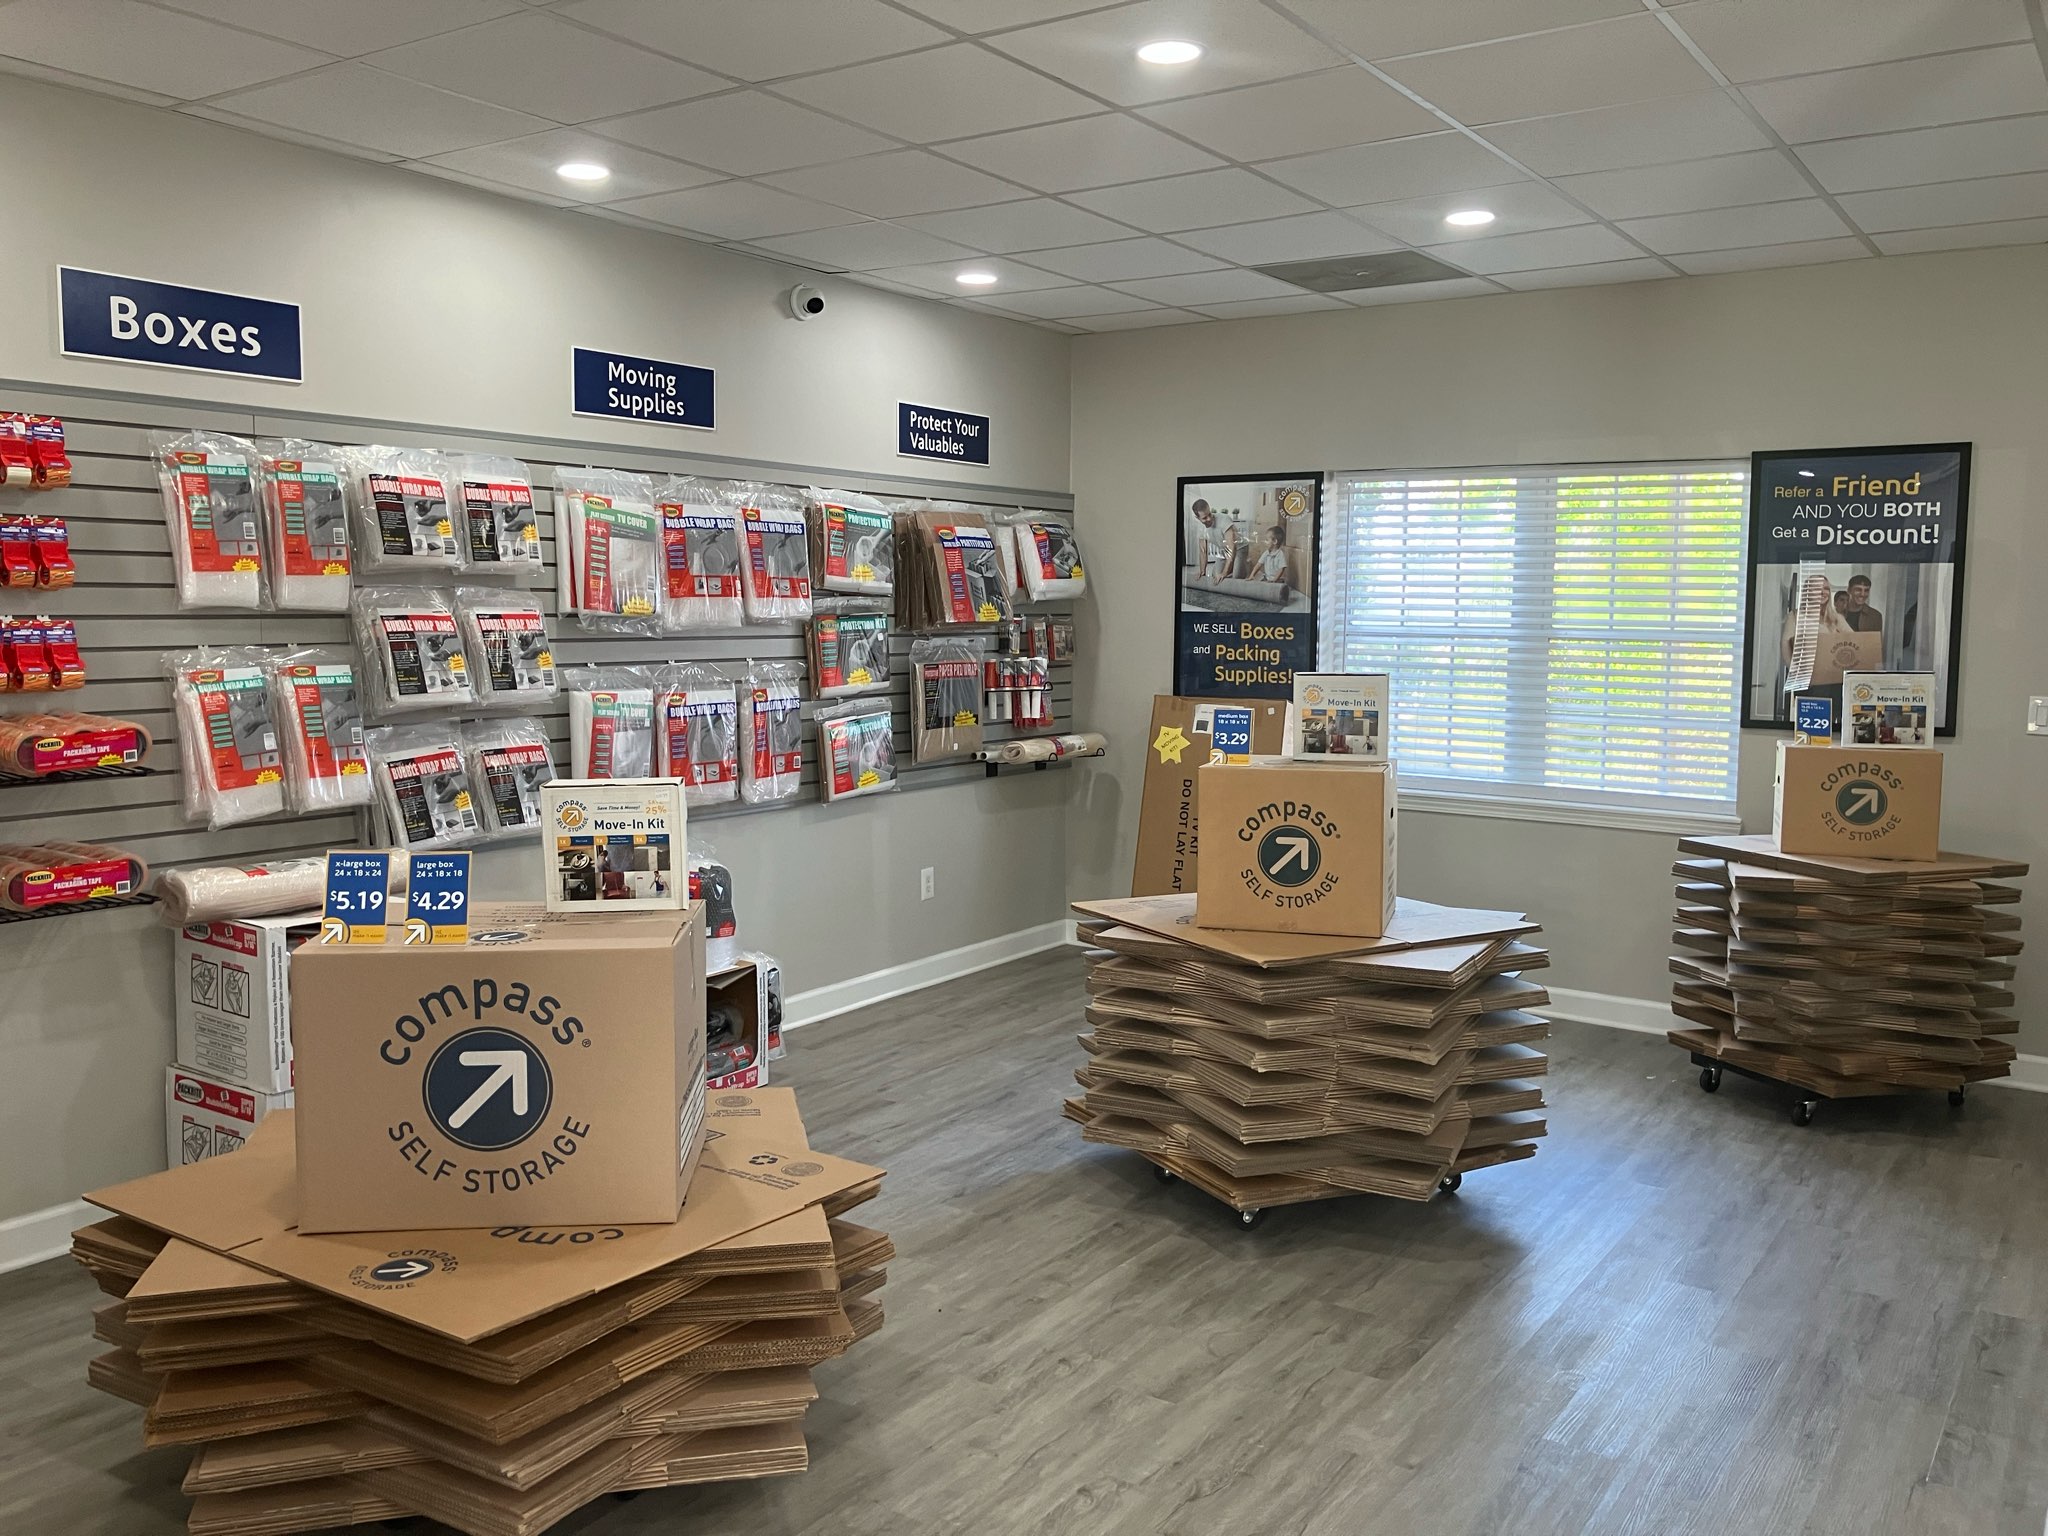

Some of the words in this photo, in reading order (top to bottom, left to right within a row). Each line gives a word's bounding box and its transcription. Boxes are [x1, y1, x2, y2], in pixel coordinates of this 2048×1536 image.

[110, 296, 261, 357] Boxes
[608, 361, 677, 396] Moving
[608, 387, 684, 416] Supplies
[910, 411, 952, 434] Protect
[954, 418, 980, 438] Your
[910, 432, 964, 455] Valuables
[372, 480, 401, 494] BUBBLE
[402, 482, 424, 495] WRAP
[424, 484, 443, 498] BAGS
[1278, 484, 1310, 501] compass
[1774, 486, 1811, 498] Refer
[1815, 488, 1824, 497] a
[1833, 471, 1920, 497] Friend
[467, 487, 490, 501] BUBBLE
[491, 490, 511, 502] WRAP
[512, 491, 529, 503] BAGS
[1792, 504, 1831, 519] AND
[1837, 503, 1877, 518] YOU
[1883, 501, 1940, 517] BOTH
[617, 513, 626, 524] TV
[627, 515, 647, 529] COVER
[848, 514, 880, 527] PROTECTION
[1772, 526, 1796, 538] Get
[1801, 528, 1809, 538] a
[1816, 523, 1939, 546] Discount!
[384, 620, 413, 631] BUBBLE
[414, 619, 435, 632] WRAP
[435, 619, 455, 632] BAGS
[480, 619, 505, 631] BUBBLE
[506, 619, 526, 631] WRAP
[875, 618, 886, 629] KIT
[1193, 624, 1209, 633] WE
[1212, 624, 1236, 634] SELL
[1240, 622, 1294, 640] Boxes
[1193, 645, 1210, 654] and
[1215, 644, 1280, 665] Packing
[1215, 666, 1292, 686] Supplies!
[1327, 699, 1361, 707] Move-In
[1364, 699, 1376, 707] Kit
[1877, 695, 1910, 703] Move-In
[1912, 695, 1924, 703] Kit
[631, 708, 648, 717] COVER
[670, 707, 696, 717] BUBBLE
[696, 705, 716, 716] WRAP
[717, 703, 736, 714] BAGS
[1799, 717, 1829, 729] $2.29
[1215, 732, 1248, 745] $3.29
[63, 747, 96, 757] PACKAGING
[97, 745, 110, 753] TAPE
[484, 753, 509, 768] BUBBLE
[508, 751, 528, 766] WRAP
[528, 749, 545, 762] BAGS
[391, 764, 417, 780] BUBBLE
[417, 759, 440, 776] WRAP
[442, 756, 459, 771] BAGS
[1820, 761, 1902, 792] compass
[1182, 779, 1192, 798] DO
[556, 800, 587, 813] compass
[646, 805, 667, 815] 25%
[1178, 801, 1190, 828] NOT
[556, 817, 569, 831] SELF
[567, 817, 589, 833] STORAGE
[594, 820, 644, 830] Move-In
[648, 818, 665, 829] Kit
[1238, 801, 1338, 842] compass
[1821, 811, 1847, 836] SELF
[1848, 814, 1902, 842] STORAGE
[1176, 831, 1187, 856] LAY
[335, 860, 363, 868] x-large
[417, 861, 437, 869] large
[53, 879, 87, 890] PACKAGING
[88, 877, 102, 886] TAPE
[1172, 859, 1184, 891] FLAT
[1241, 868, 1273, 900] SELF
[1275, 872, 1339, 909] STORAGE
[330, 890, 383, 910] $5.19
[413, 891, 464, 910] $4.29
[388, 1121, 457, 1181] SELF
[462, 1116, 590, 1194] STORAGE
[387, 1249, 459, 1273] compass
[352, 1277, 416, 1291] STORAGE
